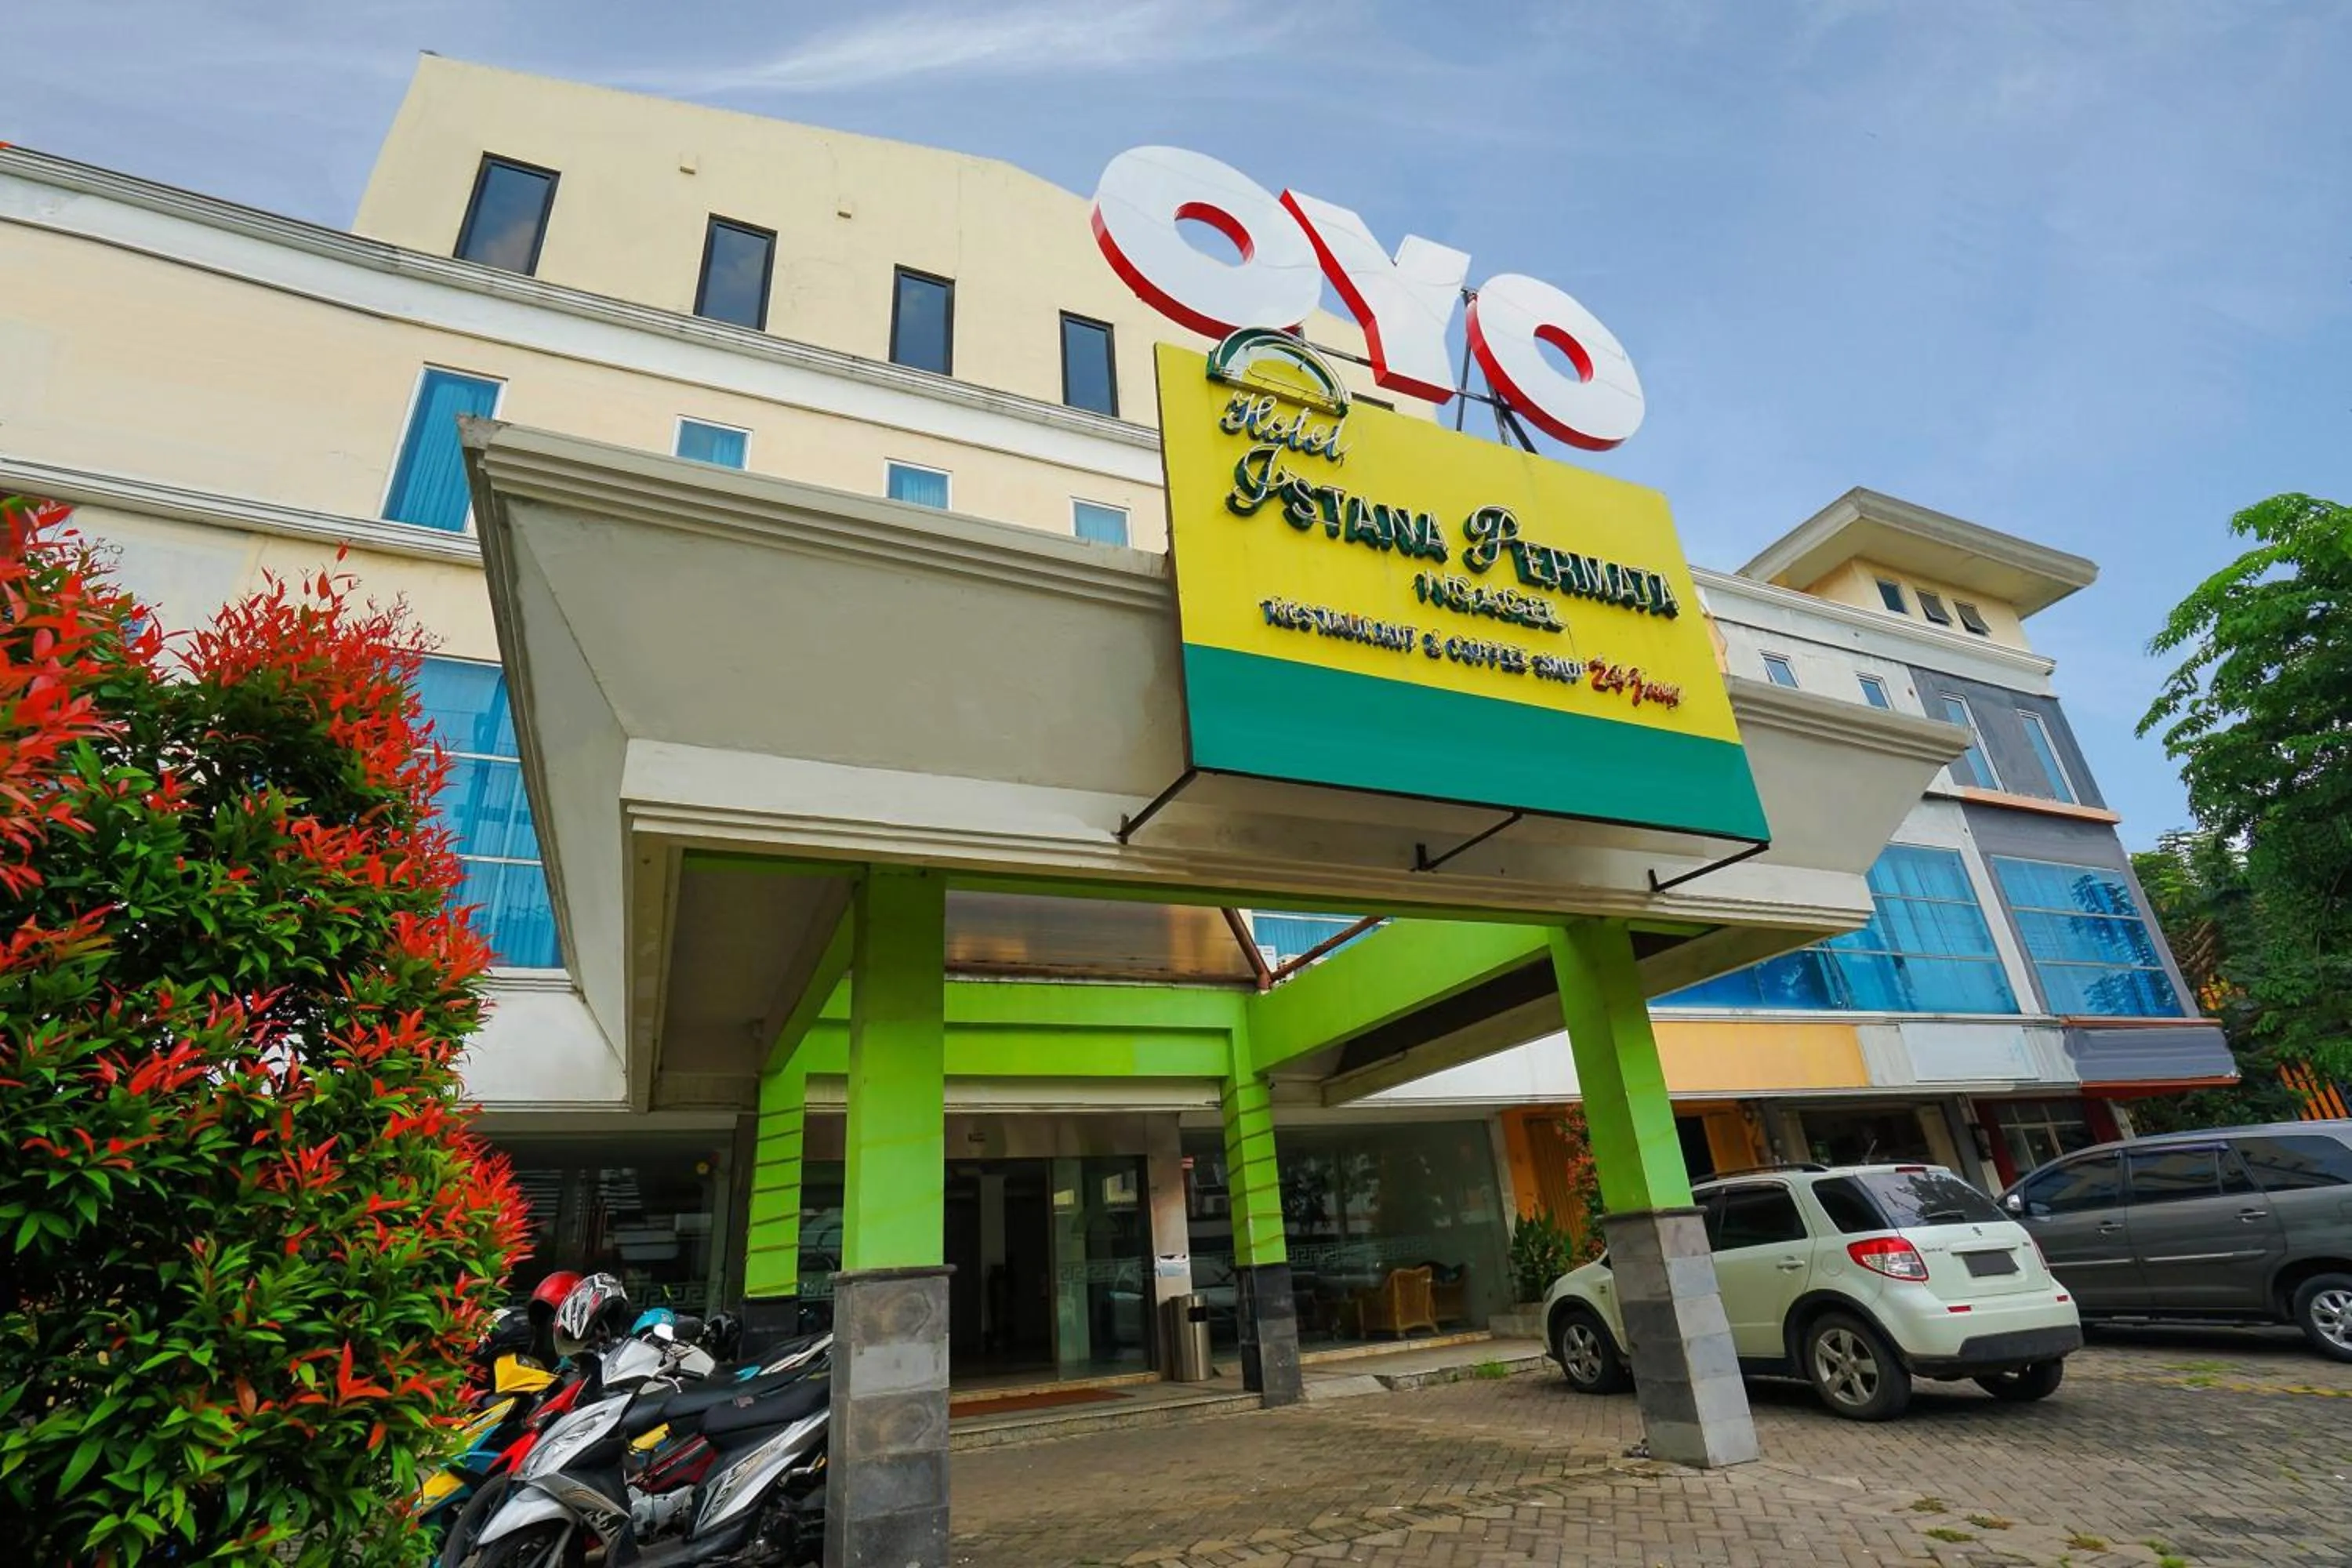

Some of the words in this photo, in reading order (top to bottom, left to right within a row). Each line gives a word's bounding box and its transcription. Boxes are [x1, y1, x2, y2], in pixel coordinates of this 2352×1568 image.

[1091, 145, 1646, 452] OYO
[1220, 390, 1352, 463] Hotel
[1225, 442, 1449, 564] ISTANA
[1461, 504, 1679, 620] PERMATA
[1259, 597, 1417, 654] RESTAURANT
[1421, 629, 1442, 659] &
